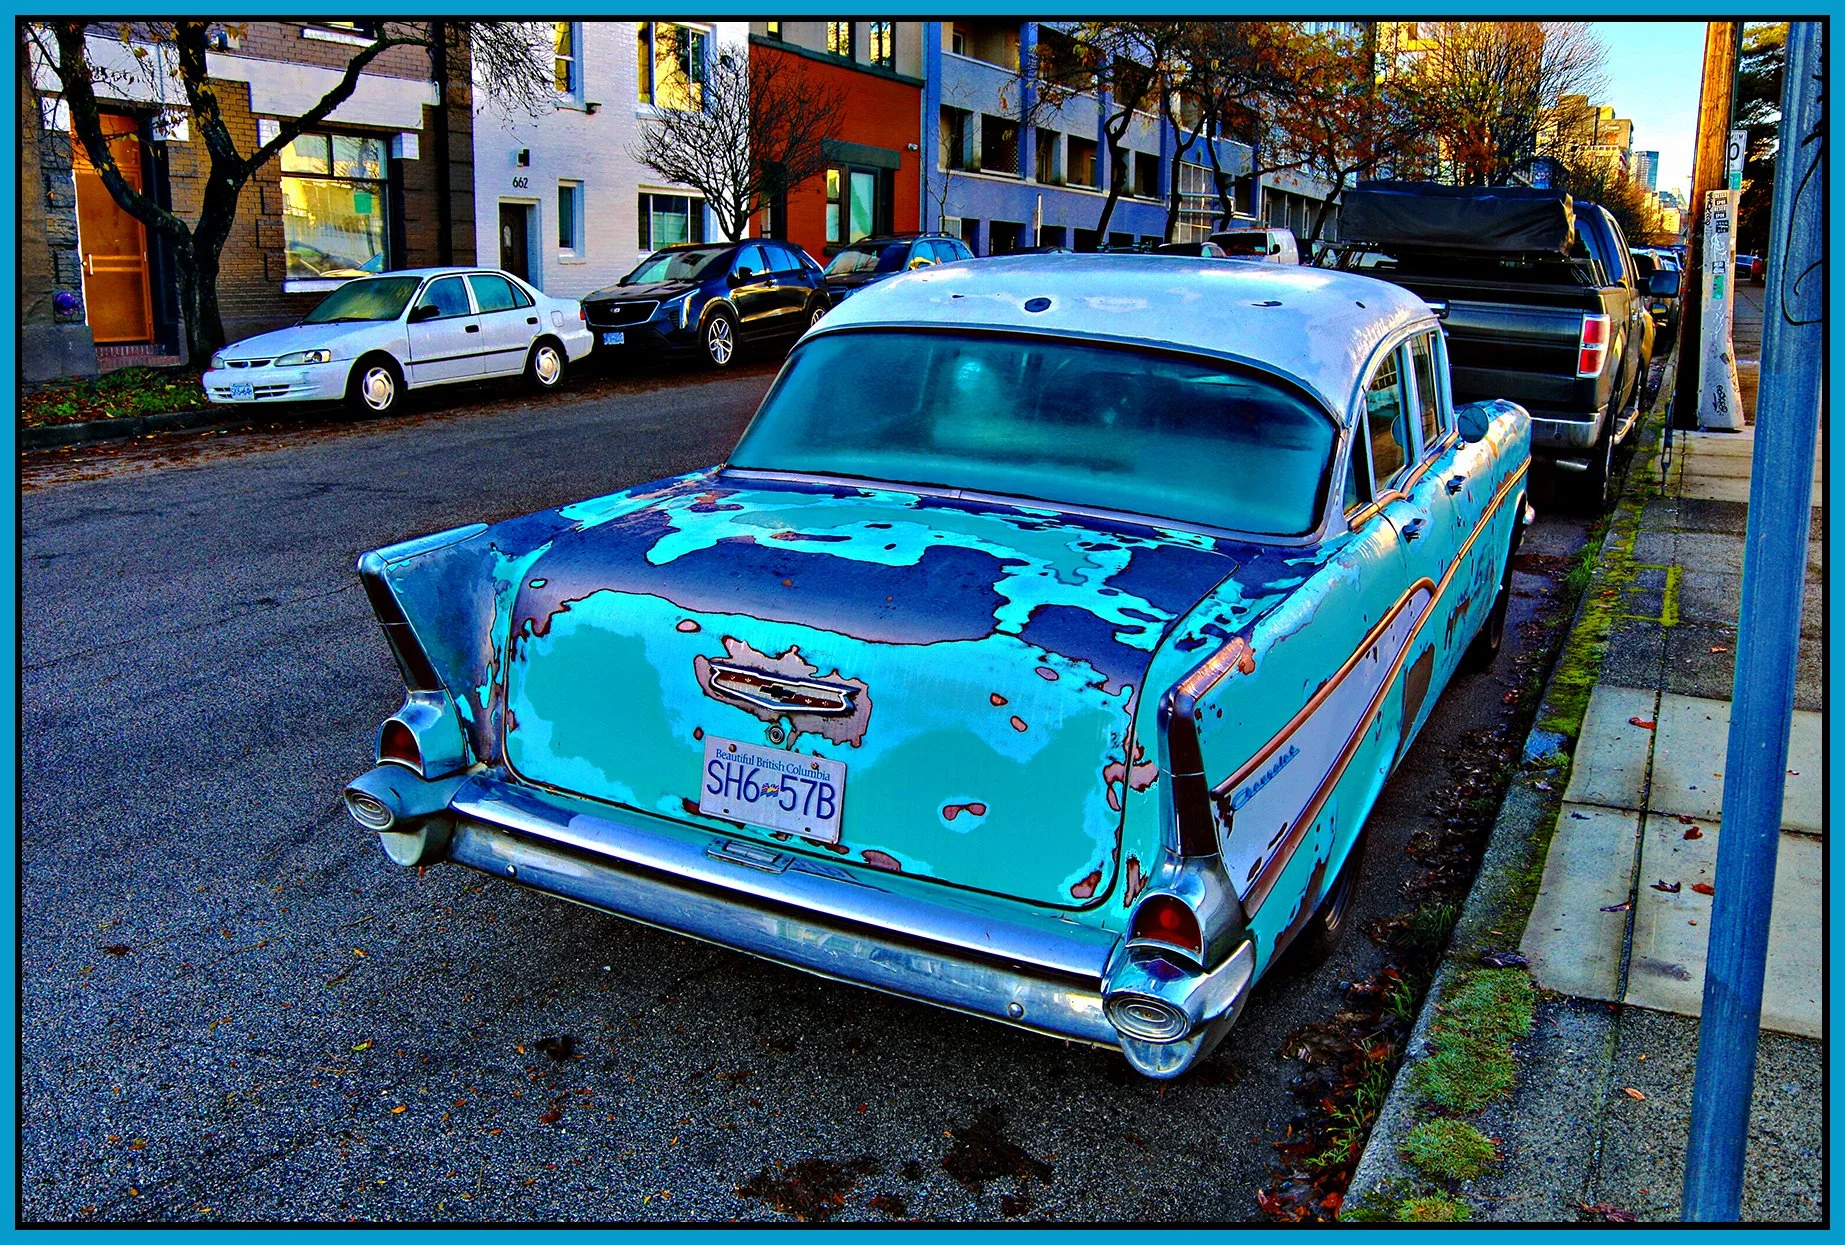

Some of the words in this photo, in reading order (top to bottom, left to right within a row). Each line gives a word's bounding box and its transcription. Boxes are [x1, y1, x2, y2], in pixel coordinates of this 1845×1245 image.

[512, 176, 529, 189] 662
[715, 748, 755, 766] Beautiful
[756, 756, 785, 773] British
[785, 763, 831, 782] Columbia
